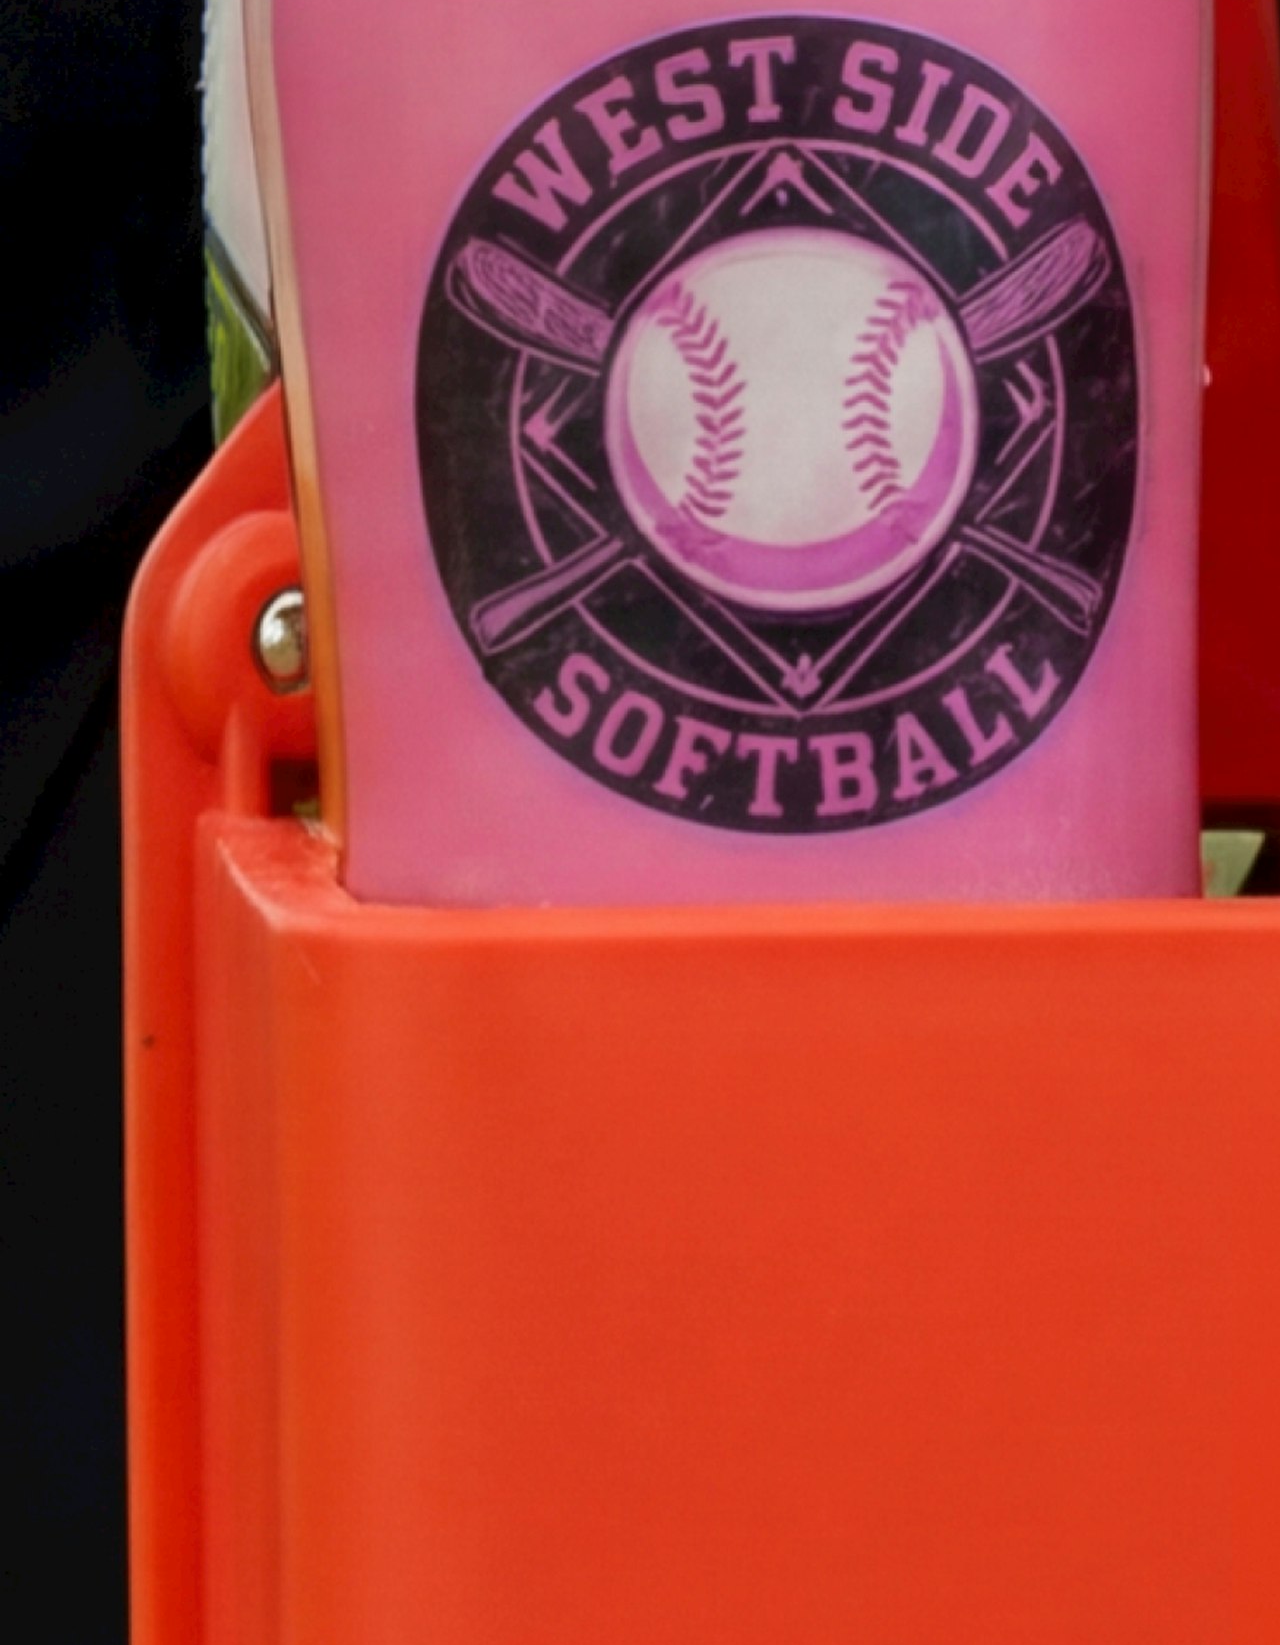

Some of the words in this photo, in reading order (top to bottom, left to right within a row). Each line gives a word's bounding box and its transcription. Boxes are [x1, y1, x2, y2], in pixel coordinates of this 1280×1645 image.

[492, 35, 796, 233] WEST
[832, 40, 1063, 229] SIDE
[532, 641, 1063, 819] SOFTBALL
